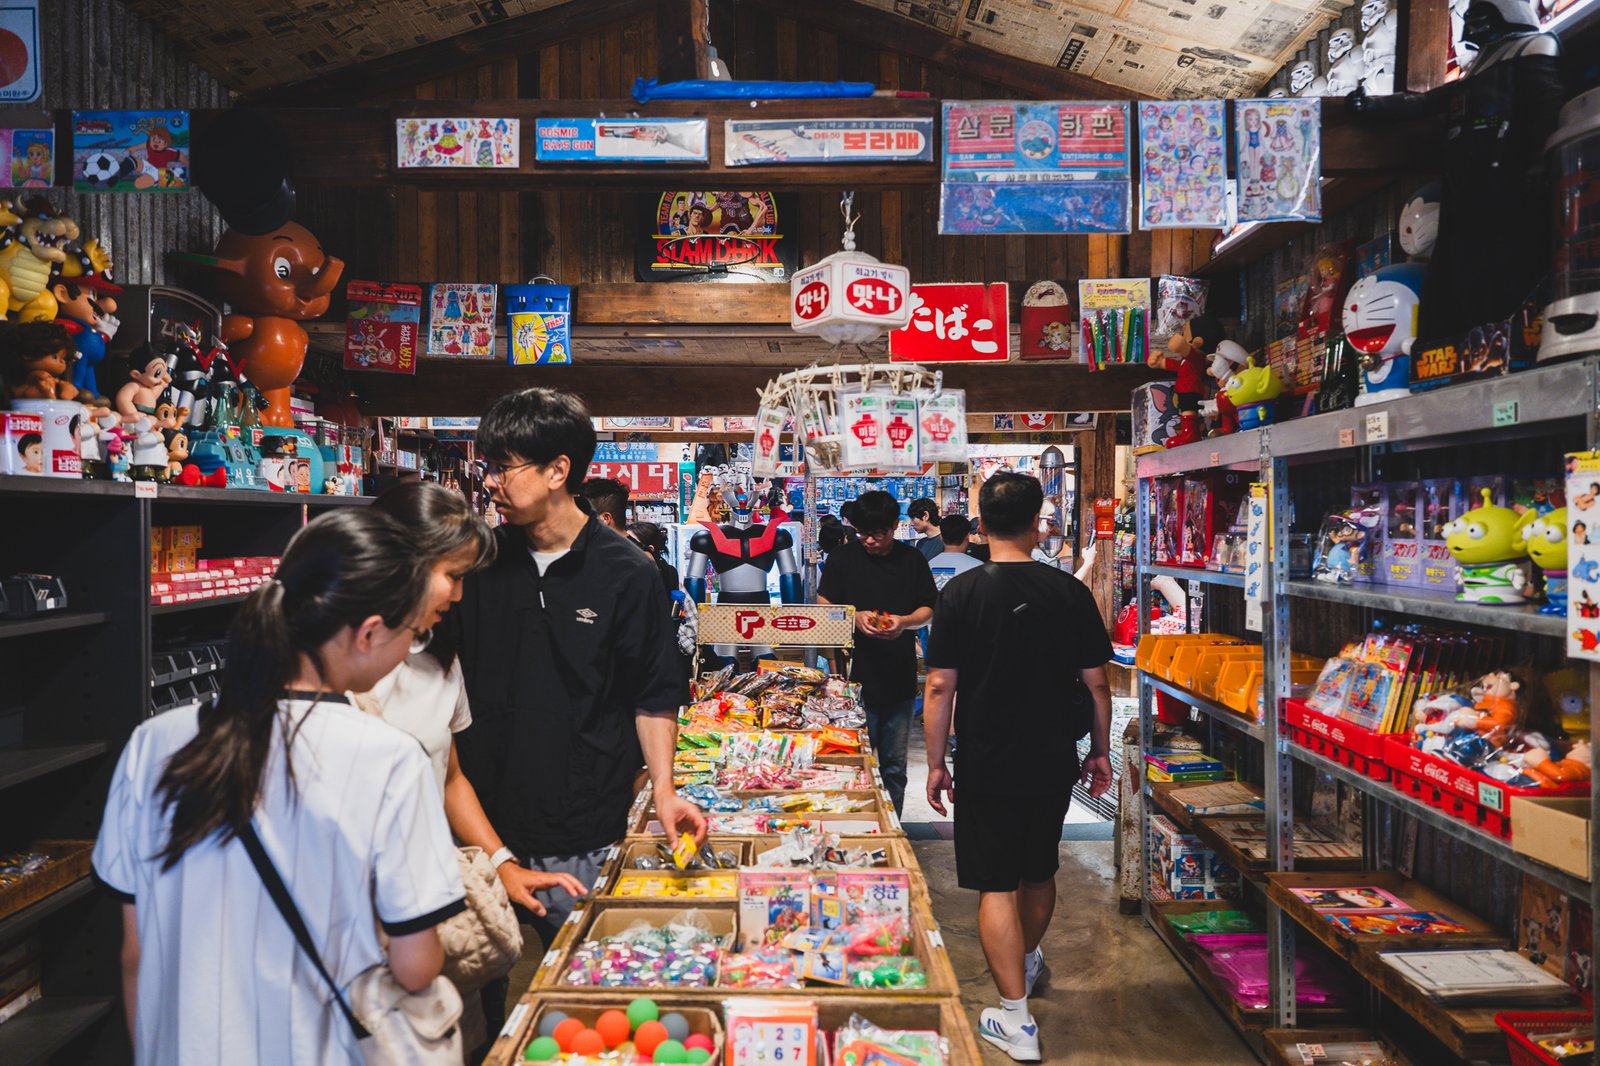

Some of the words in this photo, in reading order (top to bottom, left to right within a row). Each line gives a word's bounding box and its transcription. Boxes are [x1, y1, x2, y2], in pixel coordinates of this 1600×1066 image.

[538, 127, 579, 138] COSMIC
[843, 132, 919, 150] 보라매
[542, 140, 570, 151] RAYS
[572, 140, 595, 151] GUN
[659, 204, 671, 224] TEAM
[765, 205, 775, 224] CLUB
[656, 239, 713, 264] SLAM
[715, 239, 779, 264] DUNK
[798, 286, 828, 317] 맛나
[852, 284, 899, 312] 맛나
[901, 290, 999, 352] たばこ
[1416, 345, 1458, 367] STAR
[1416, 358, 1457, 379] WARS
[858, 425, 877, 437] 미원
[890, 429, 907, 439] 미원
[235, 467, 255, 486] 서울
[585, 464, 674, 490] 다시다
[775, 1027, 784, 1041] 2
[793, 1027, 802, 1041] 3
[738, 1046, 747, 1059] 4
[774, 1046, 784, 1061] 6
[792, 1047, 801, 1061] 7
